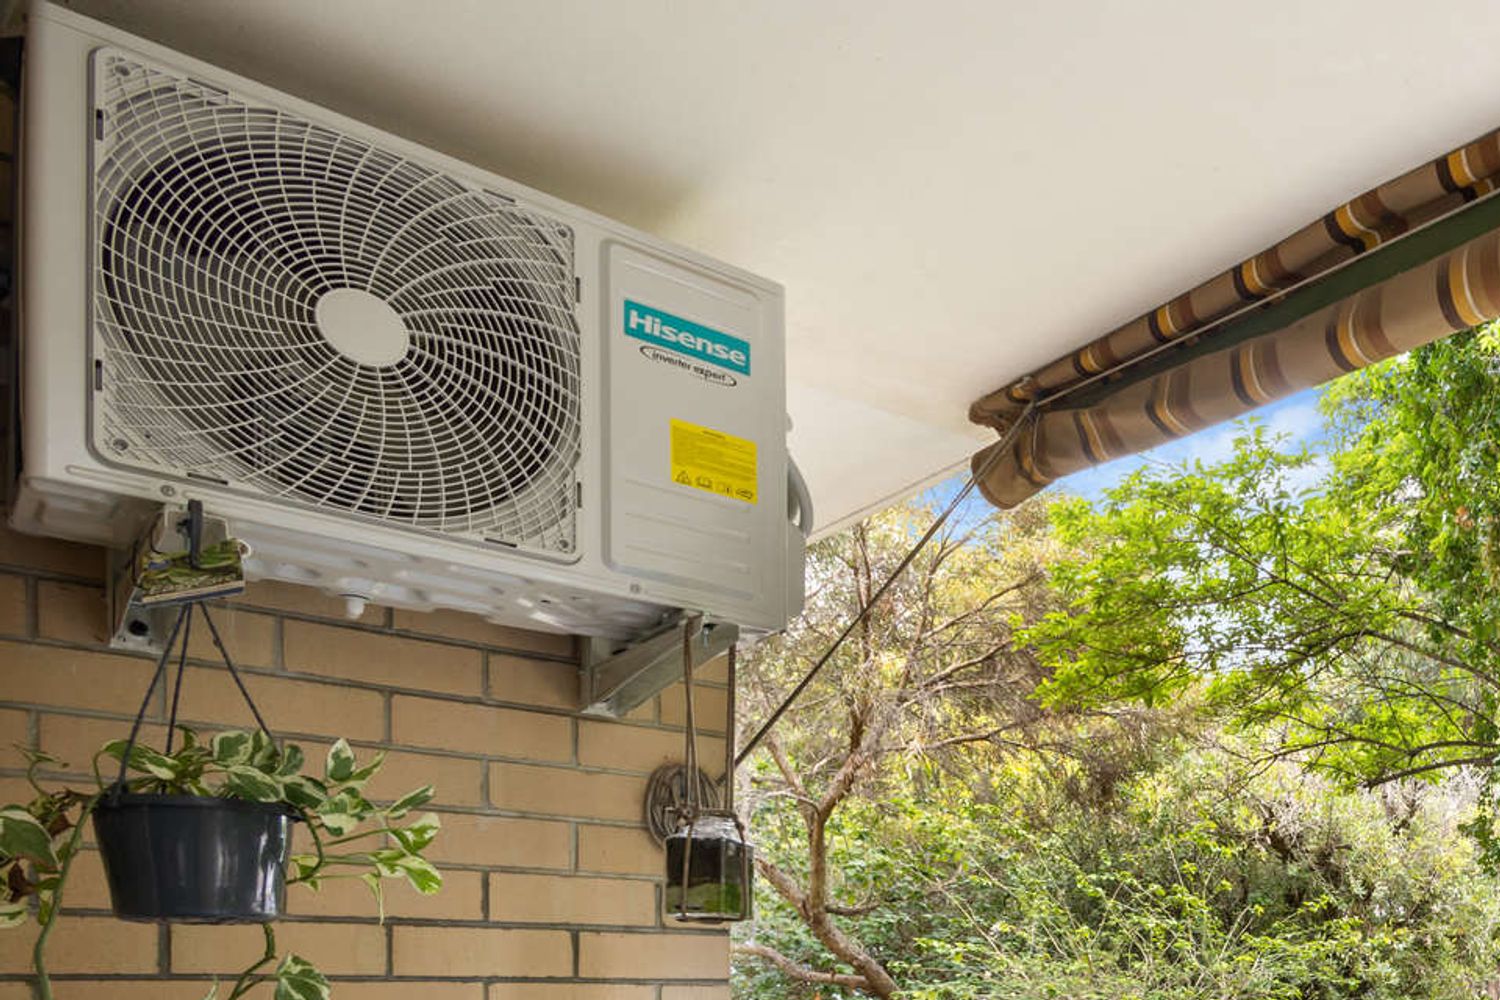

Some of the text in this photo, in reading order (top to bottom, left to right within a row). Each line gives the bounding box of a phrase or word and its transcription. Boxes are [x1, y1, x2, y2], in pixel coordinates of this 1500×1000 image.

[630, 309, 746, 366] Hisense
[652, 353, 726, 381] inverter expert
